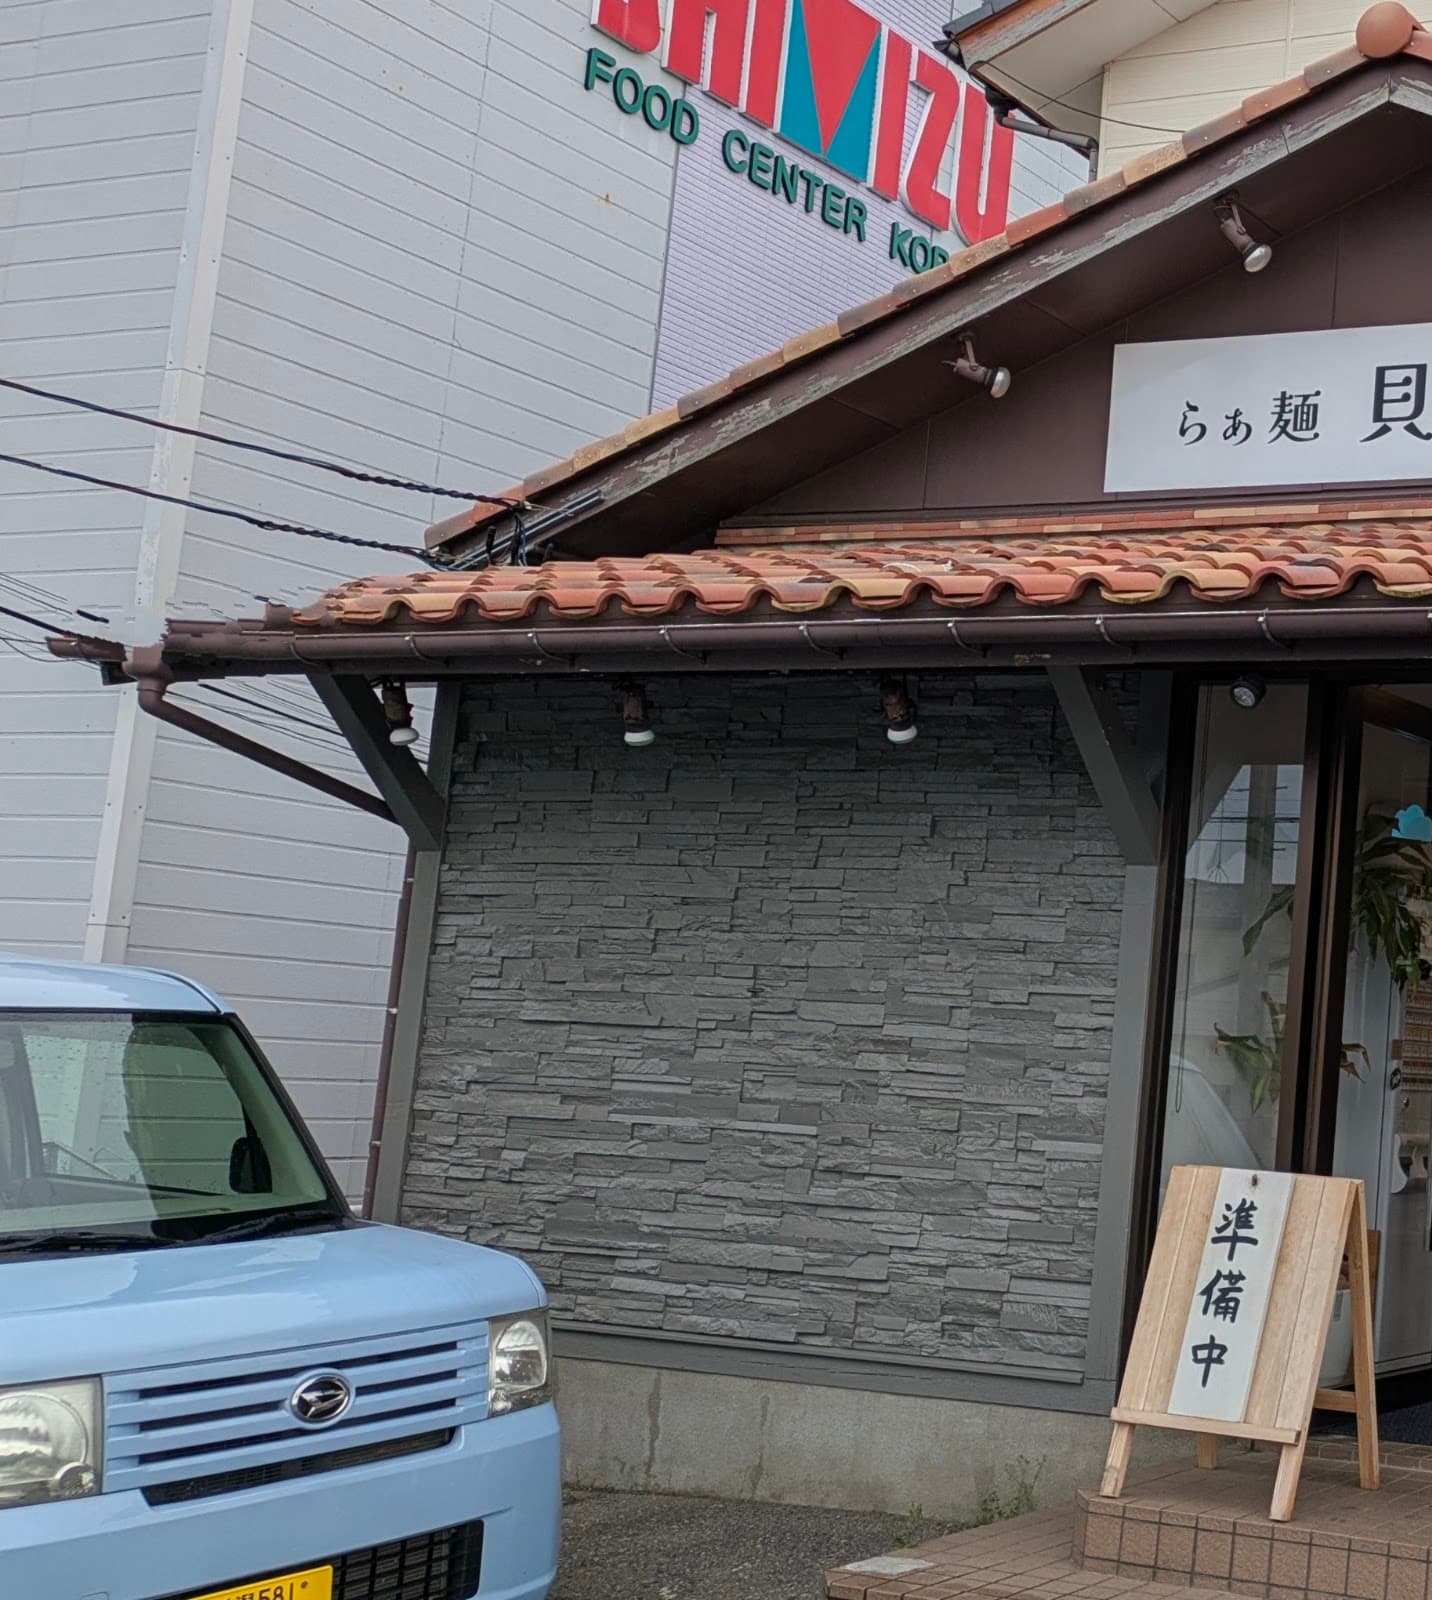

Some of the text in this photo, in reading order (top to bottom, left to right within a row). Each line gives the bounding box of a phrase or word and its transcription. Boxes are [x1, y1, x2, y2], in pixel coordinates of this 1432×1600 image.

[584, 47, 700, 146] FOOD
[722, 129, 867, 243] CENTER
[1191, 1197, 1259, 1388] 準備中
